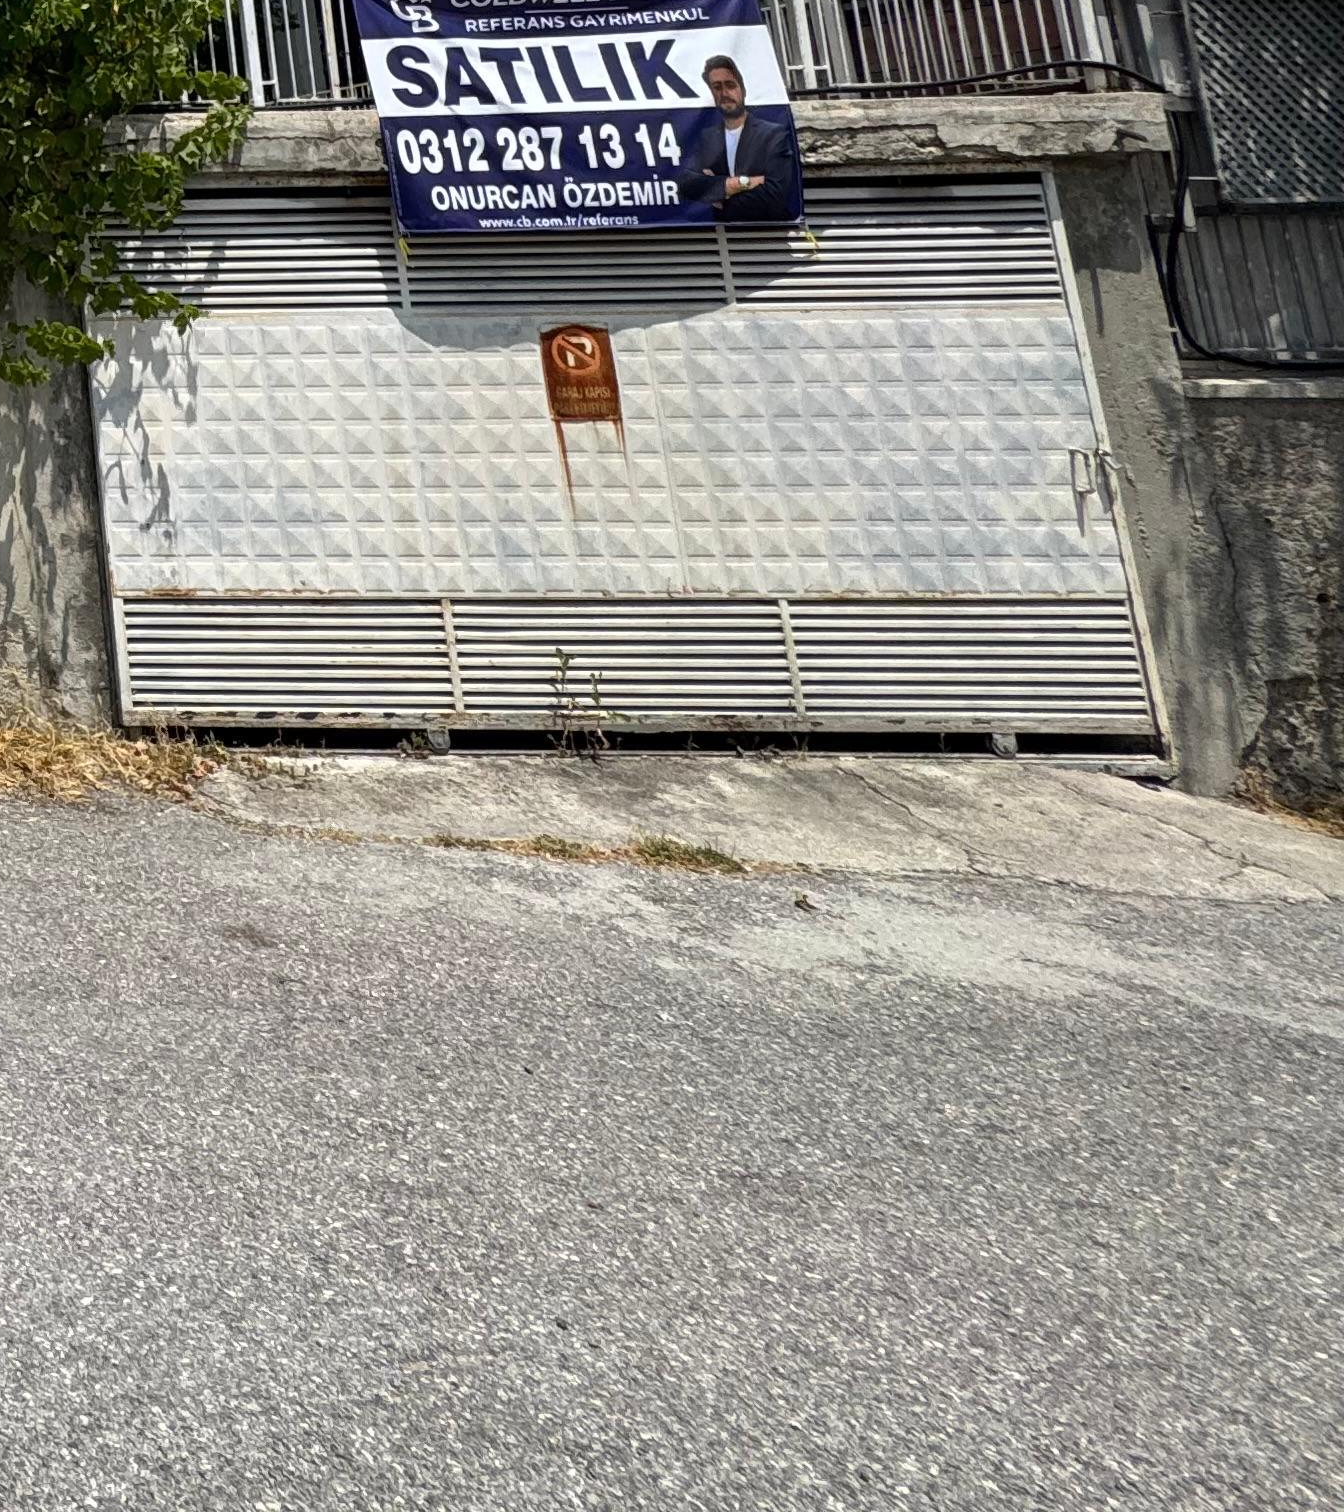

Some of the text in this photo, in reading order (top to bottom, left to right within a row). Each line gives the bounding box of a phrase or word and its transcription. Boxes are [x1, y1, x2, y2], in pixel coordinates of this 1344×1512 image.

[465, 16, 565, 32] REFERANS
[386, 39, 700, 108] SATILIK
[397, 128, 490, 174] 0312
[496, 126, 562, 171] 287
[578, 123, 625, 169] 13
[634, 122, 681, 167] 14
[431, 173, 680, 211] ONURCAN ÖZDEMİR
[478, 212, 639, 228] www.cb.com.tr/referans
